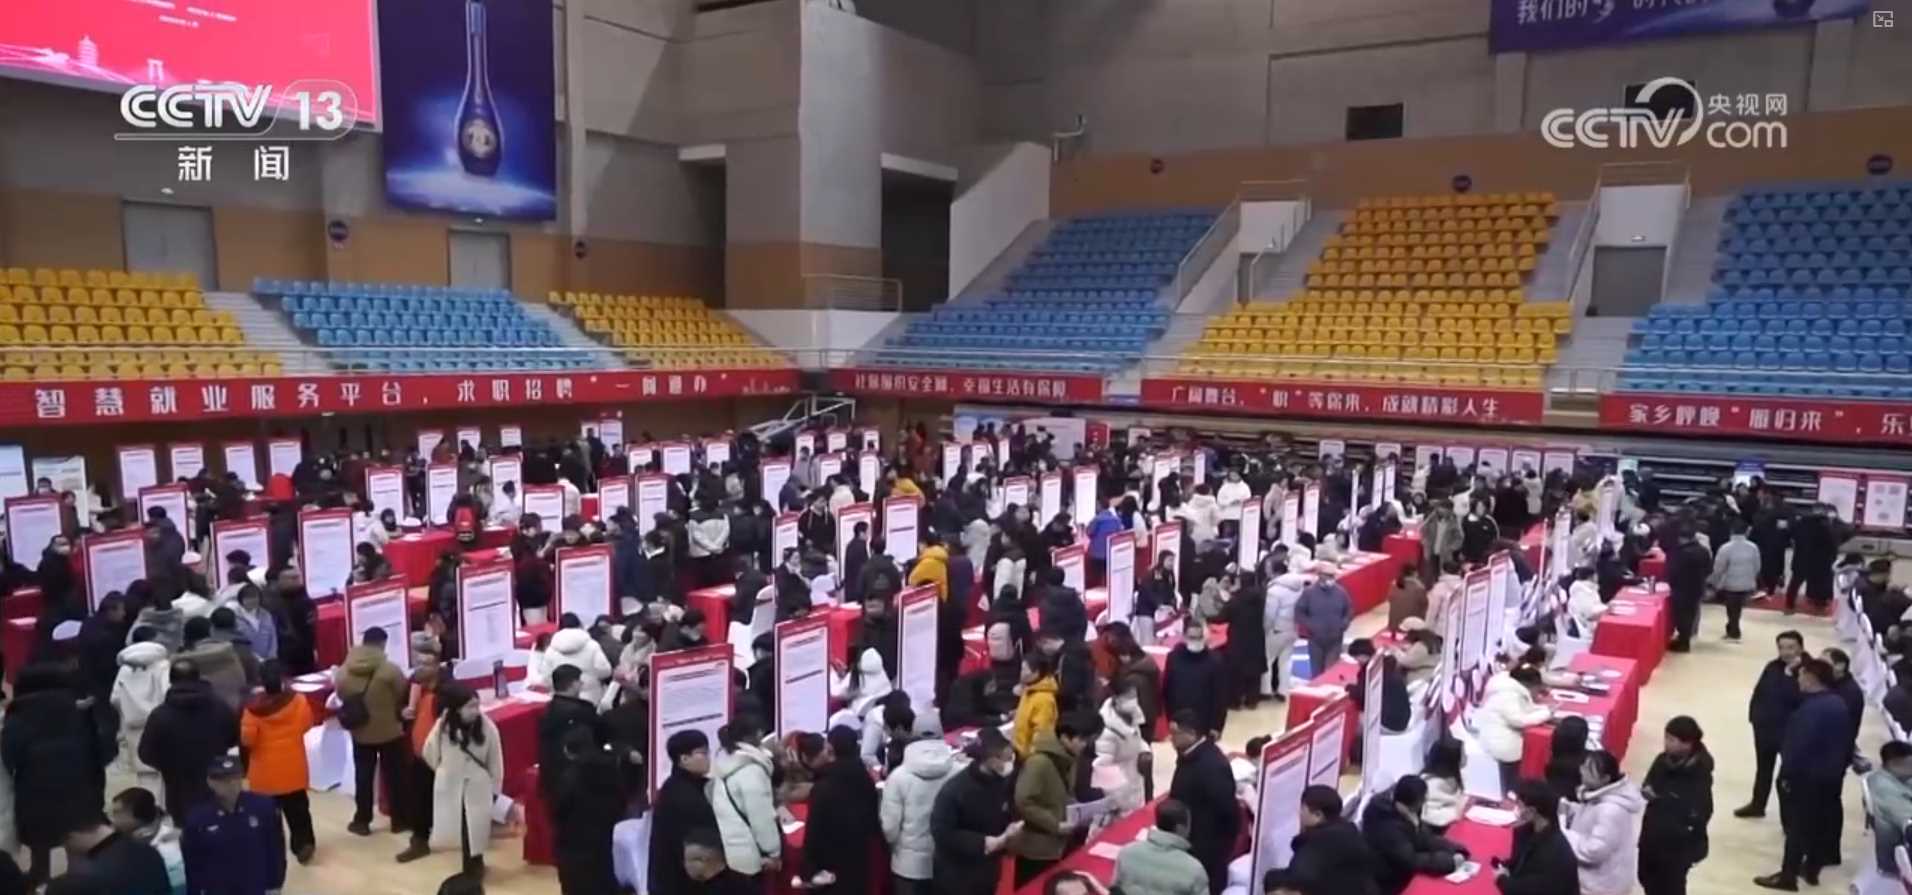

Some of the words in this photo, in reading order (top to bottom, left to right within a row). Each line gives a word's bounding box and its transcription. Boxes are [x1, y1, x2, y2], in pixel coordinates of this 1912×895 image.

[1630, 403, 1912, 437] 家乡呼唤“雁归来”，乐
